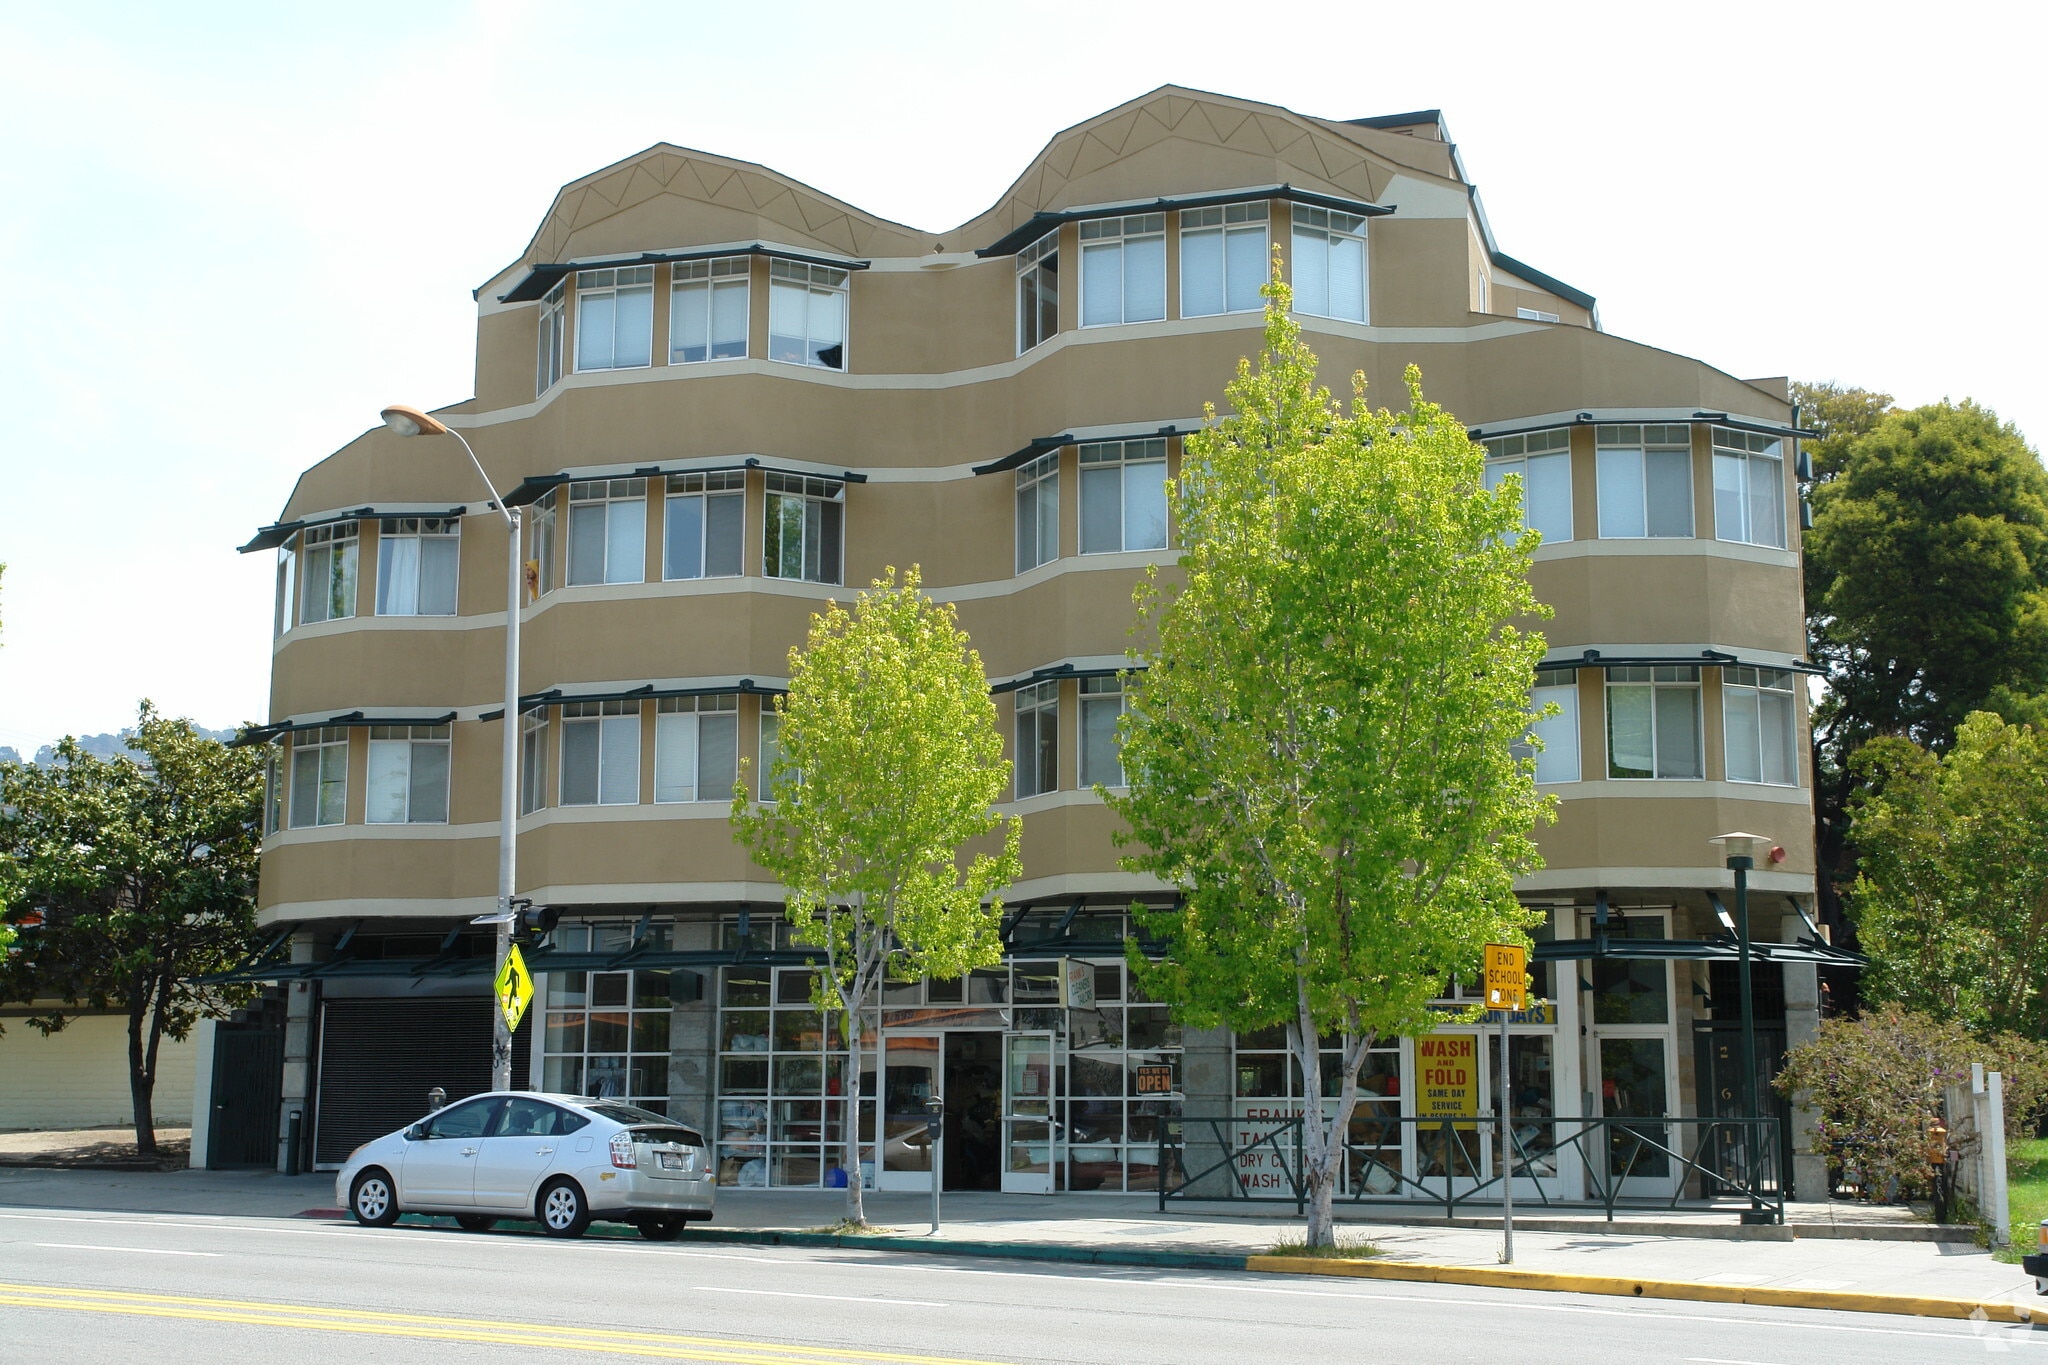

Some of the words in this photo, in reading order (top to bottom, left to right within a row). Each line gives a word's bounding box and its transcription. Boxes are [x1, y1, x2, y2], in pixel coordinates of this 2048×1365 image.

[1497, 951, 1515, 966] END
[1489, 969, 1523, 985] SCHOOL
[1494, 987, 1518, 1002] ONE
[1421, 1040, 1471, 1057] WASH
[1436, 1059, 1455, 1067] AND
[1138, 1075, 1171, 1092] OPEN
[1425, 1068, 1467, 1086] FOLD
[1427, 1088, 1449, 1098] SAME
[1451, 1088, 1466, 1098] DAY
[1431, 1101, 1463, 1110] SERVICE
[1240, 1153, 1264, 1168] DRY
[1240, 1173, 1281, 1189] WASH
